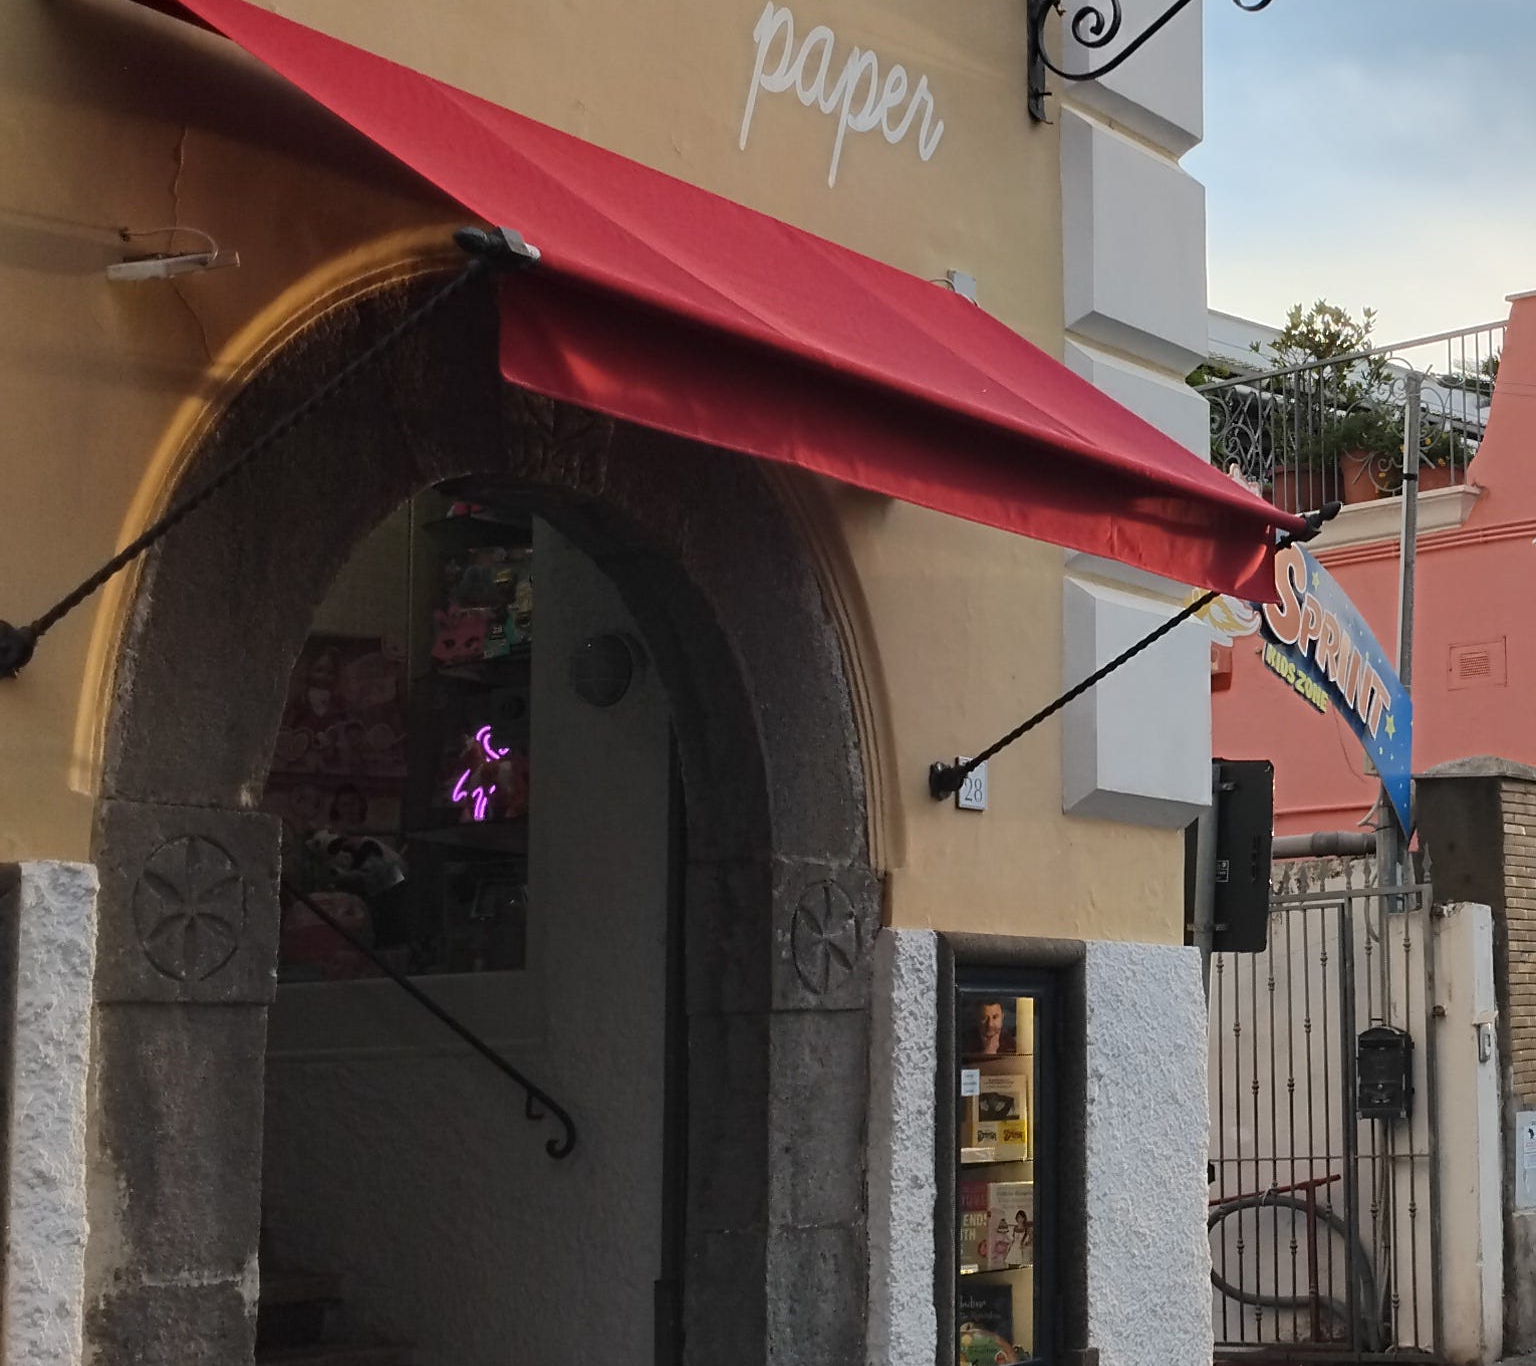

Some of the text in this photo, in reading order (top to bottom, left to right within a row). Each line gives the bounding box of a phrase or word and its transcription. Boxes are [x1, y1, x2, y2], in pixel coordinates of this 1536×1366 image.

[738, 0, 945, 189] paper
[1263, 540, 1392, 740] SPRINT
[1266, 642, 1329, 713] KIDS ZONE
[964, 777, 983, 803] 28
